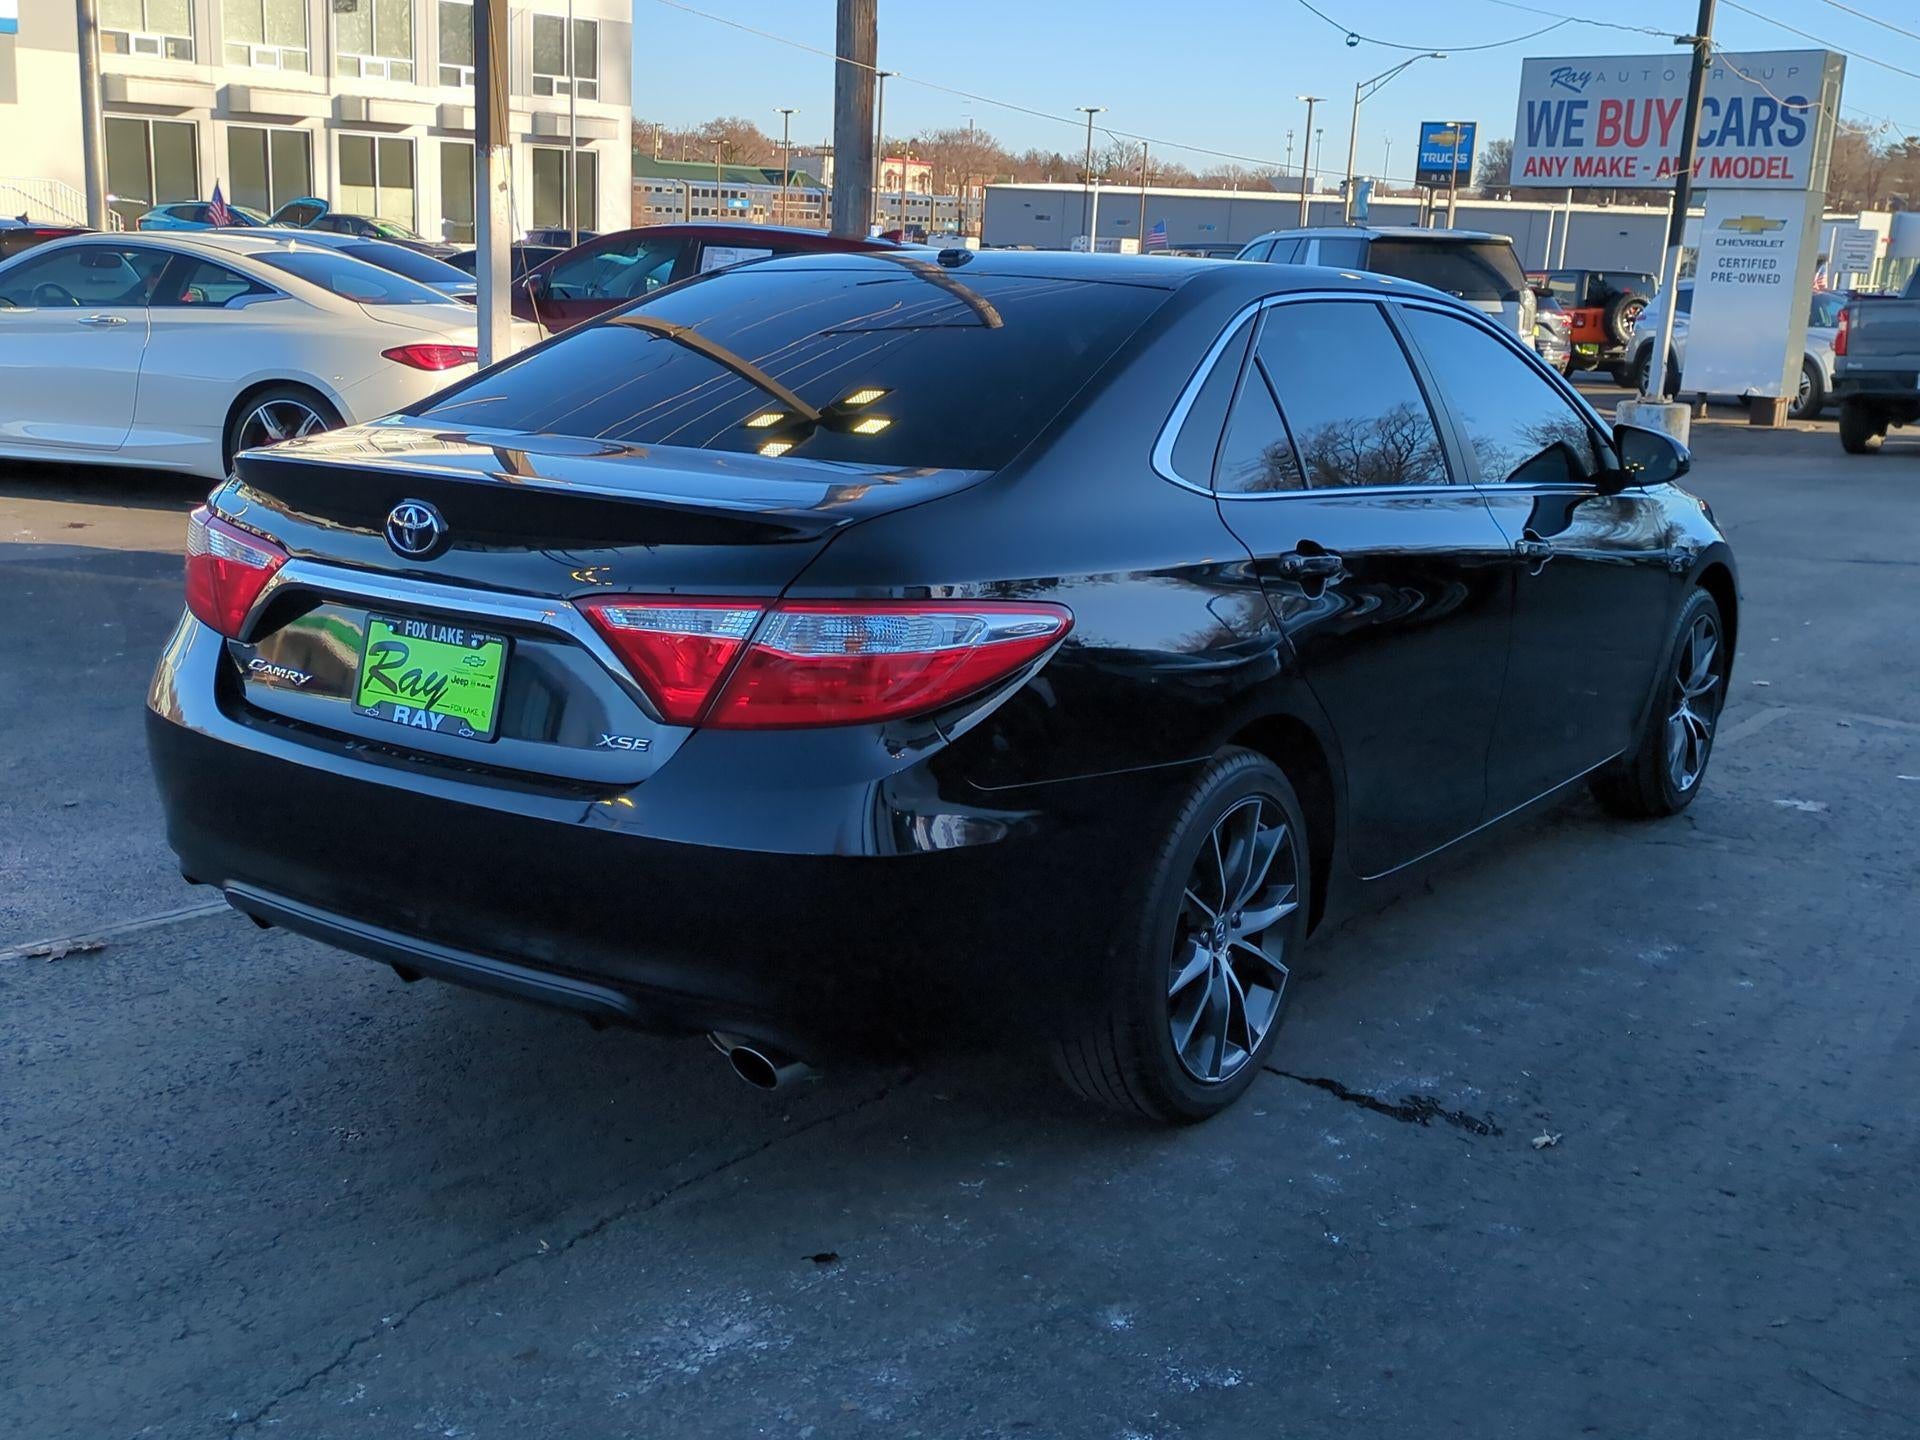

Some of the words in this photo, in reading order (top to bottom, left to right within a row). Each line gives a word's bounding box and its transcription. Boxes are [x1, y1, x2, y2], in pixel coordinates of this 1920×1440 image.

[1550, 66, 1592, 93] Ray
[1596, 69, 1676, 82] AUTO
[1688, 66, 1800, 81] ROUP
[1526, 99, 1589, 148] WE
[1596, 97, 1684, 148] BUY
[1697, 95, 1809, 148] CARS
[1523, 156, 1569, 178] ANY
[1573, 156, 1638, 178] MAKE
[1710, 156, 1794, 179] MODEL
[1715, 238, 1785, 248] CHEVROLET
[1718, 257, 1777, 270] CERTIFIED
[1710, 271, 1781, 285] PRE-OWNED
[405, 620, 429, 639] FOX
[431, 624, 465, 645] LAKE
[363, 640, 449, 711] Ray
[450, 674, 469, 688] Jeep
[393, 704, 445, 731] RAY
[595, 734, 651, 751] XSE
